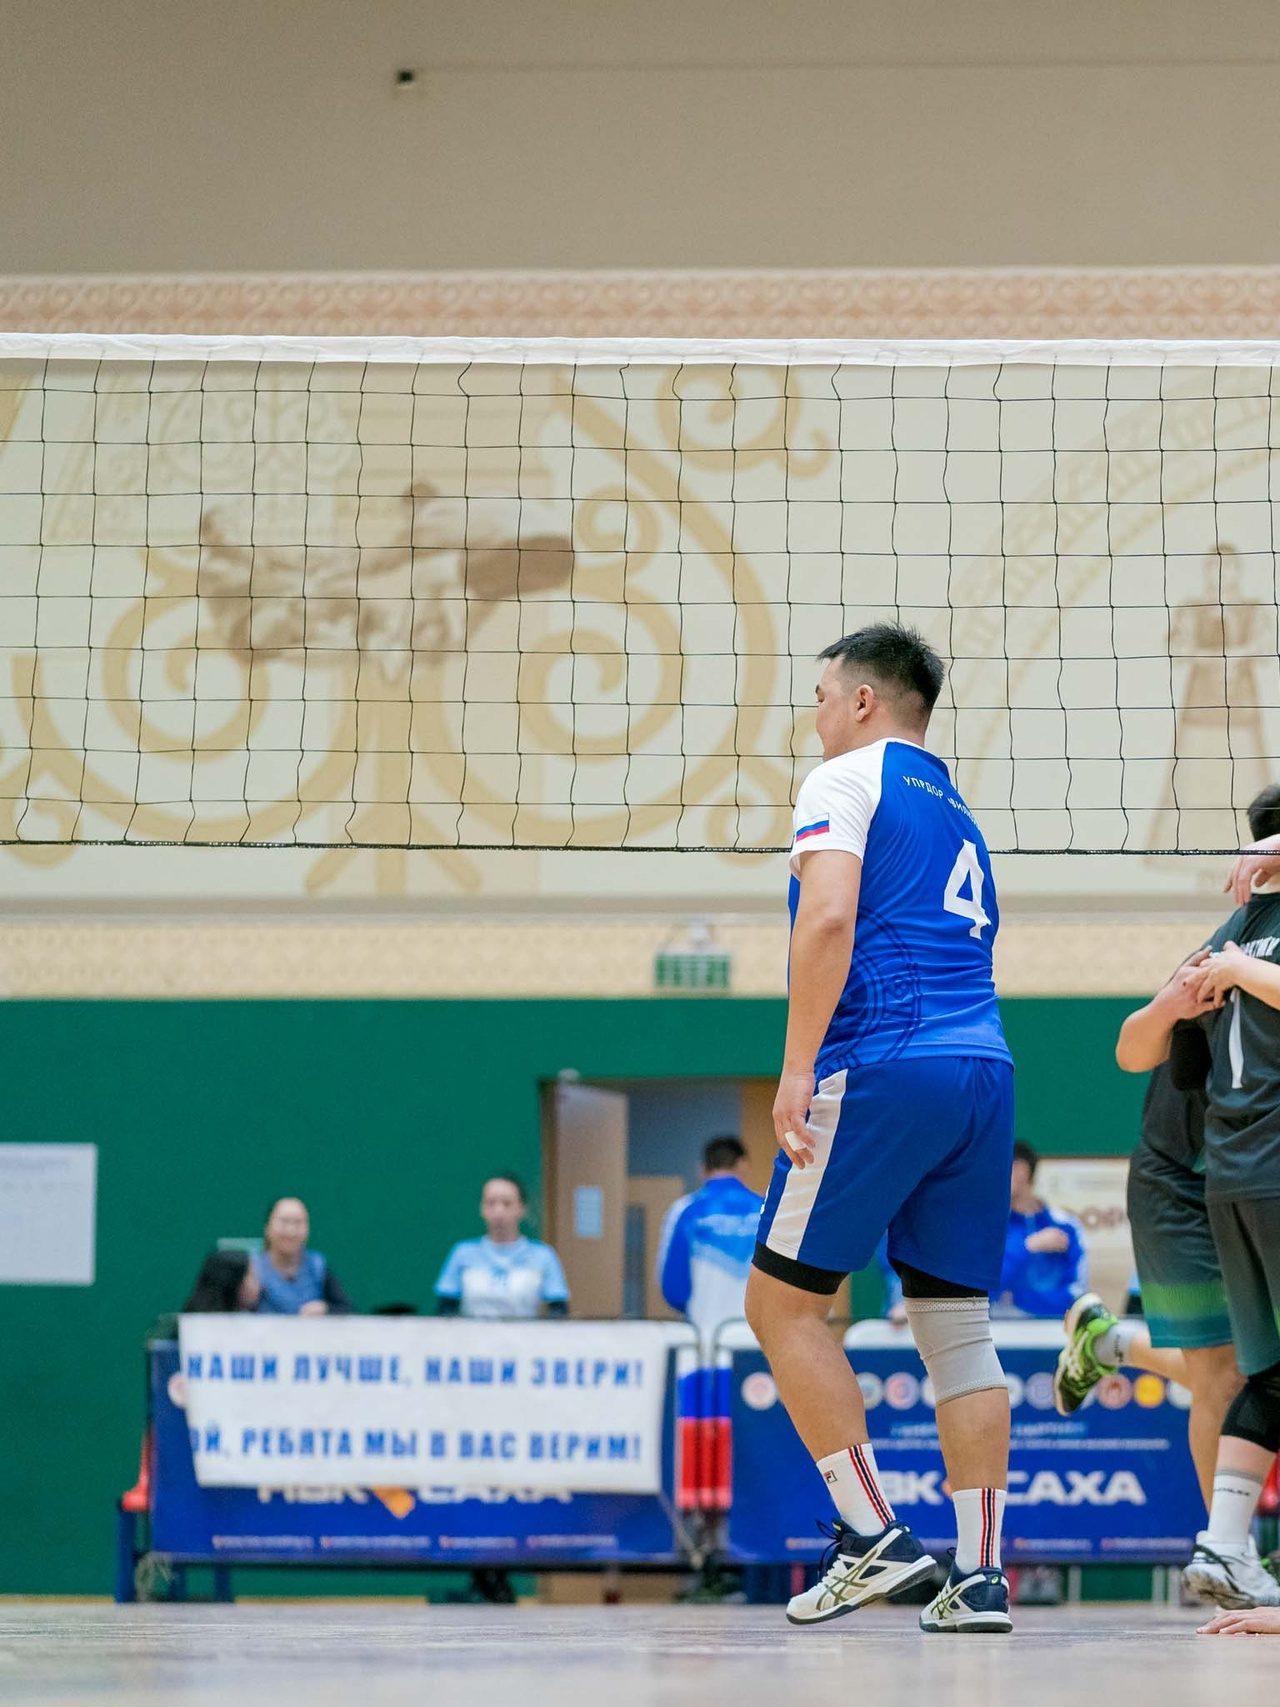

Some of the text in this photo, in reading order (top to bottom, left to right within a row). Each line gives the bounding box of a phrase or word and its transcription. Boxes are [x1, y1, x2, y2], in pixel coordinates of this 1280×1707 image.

[902, 775, 944, 799] УПРДОР
[943, 838, 992, 941] 4
[187, 1353, 278, 1382] НАШИ
[425, 1356, 516, 1385] НАШИ
[531, 1358, 643, 1388] ЗВЕРИ!
[241, 1428, 353, 1457] РЕБЯТА
[364, 1429, 418, 1458] МЫ
[430, 1431, 446, 1459] В
[458, 1431, 517, 1460] ВАС
[529, 1432, 641, 1462] ВЕРИМ!
[879, 1470, 1148, 1506] ВК САХА
